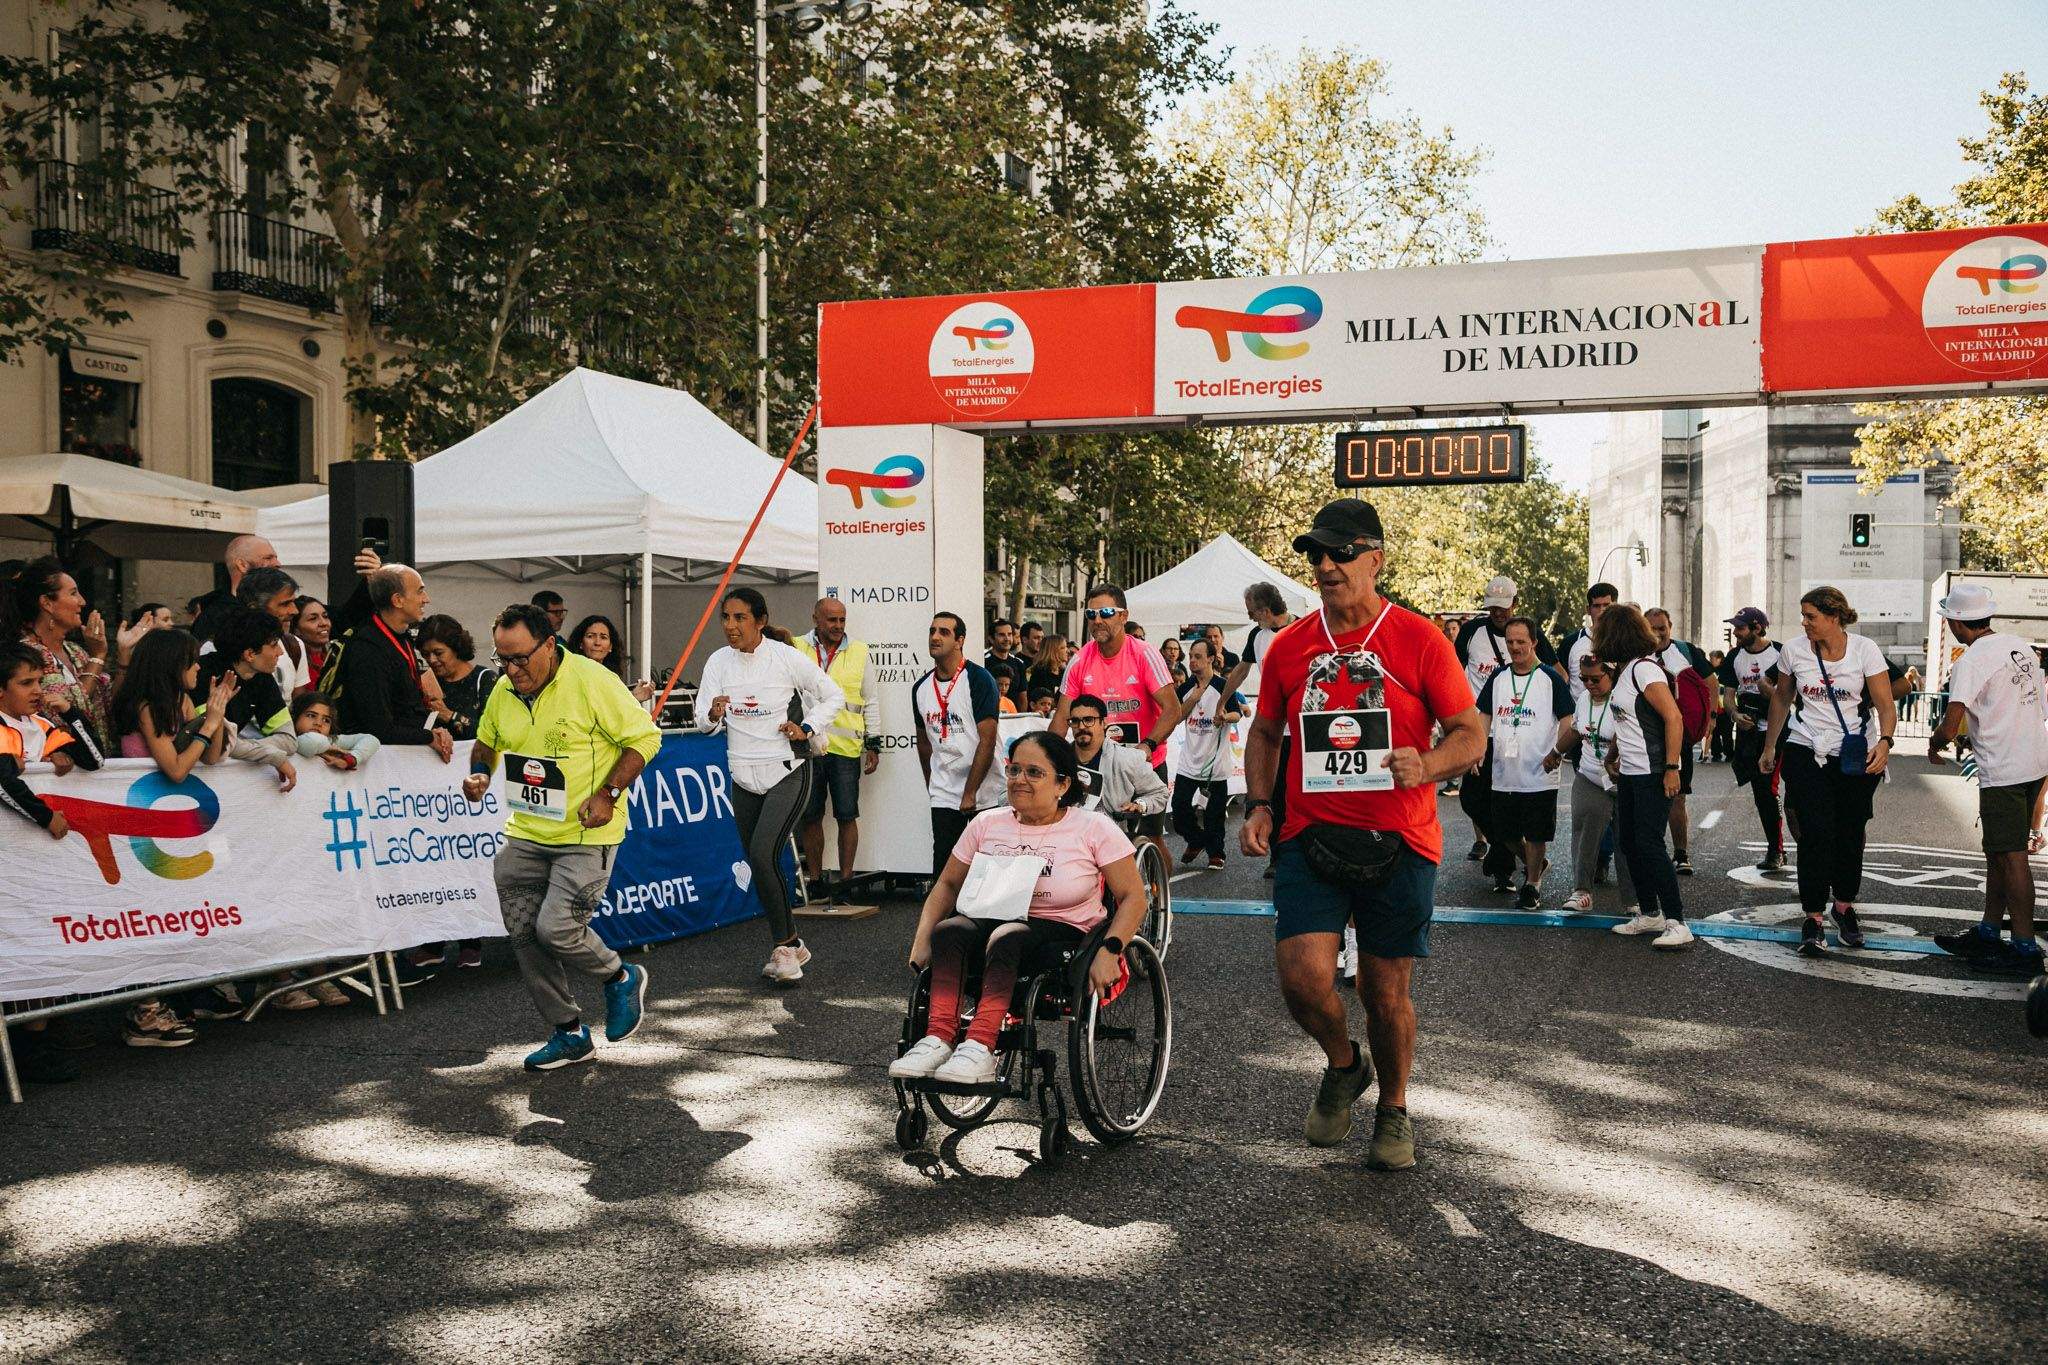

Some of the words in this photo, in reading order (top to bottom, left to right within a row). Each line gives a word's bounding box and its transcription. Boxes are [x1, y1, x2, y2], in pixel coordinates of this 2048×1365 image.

[1955, 301, 2047, 316] TotalEnergies
[1345, 314, 1450, 344] MILLA
[1977, 326, 2020, 338] MILLA
[952, 356, 1015, 368] TotalEnergies
[1443, 346, 1488, 373] DE
[1497, 340, 1639, 371] MADRID
[1961, 352, 1980, 362] DE
[1983, 350, 2036, 362] MADRID
[84, 357, 129, 374] CASTIZO
[967, 377, 996, 386] MILLA
[1174, 375, 1323, 399] TotalEnergies
[956, 398, 970, 407] DE
[970, 396, 1007, 406] MADRID
[1347, 433, 1511, 479] 00:00:00
[190, 508, 222, 520] CASTIZO
[825, 518, 926, 536] TotalEnergies
[851, 586, 930, 604] MADRID
[1324, 751, 1368, 775] 429
[521, 785, 548, 806] 461
[616, 875, 699, 916] DEPORTE
[52, 900, 244, 945] TotalEnergies
